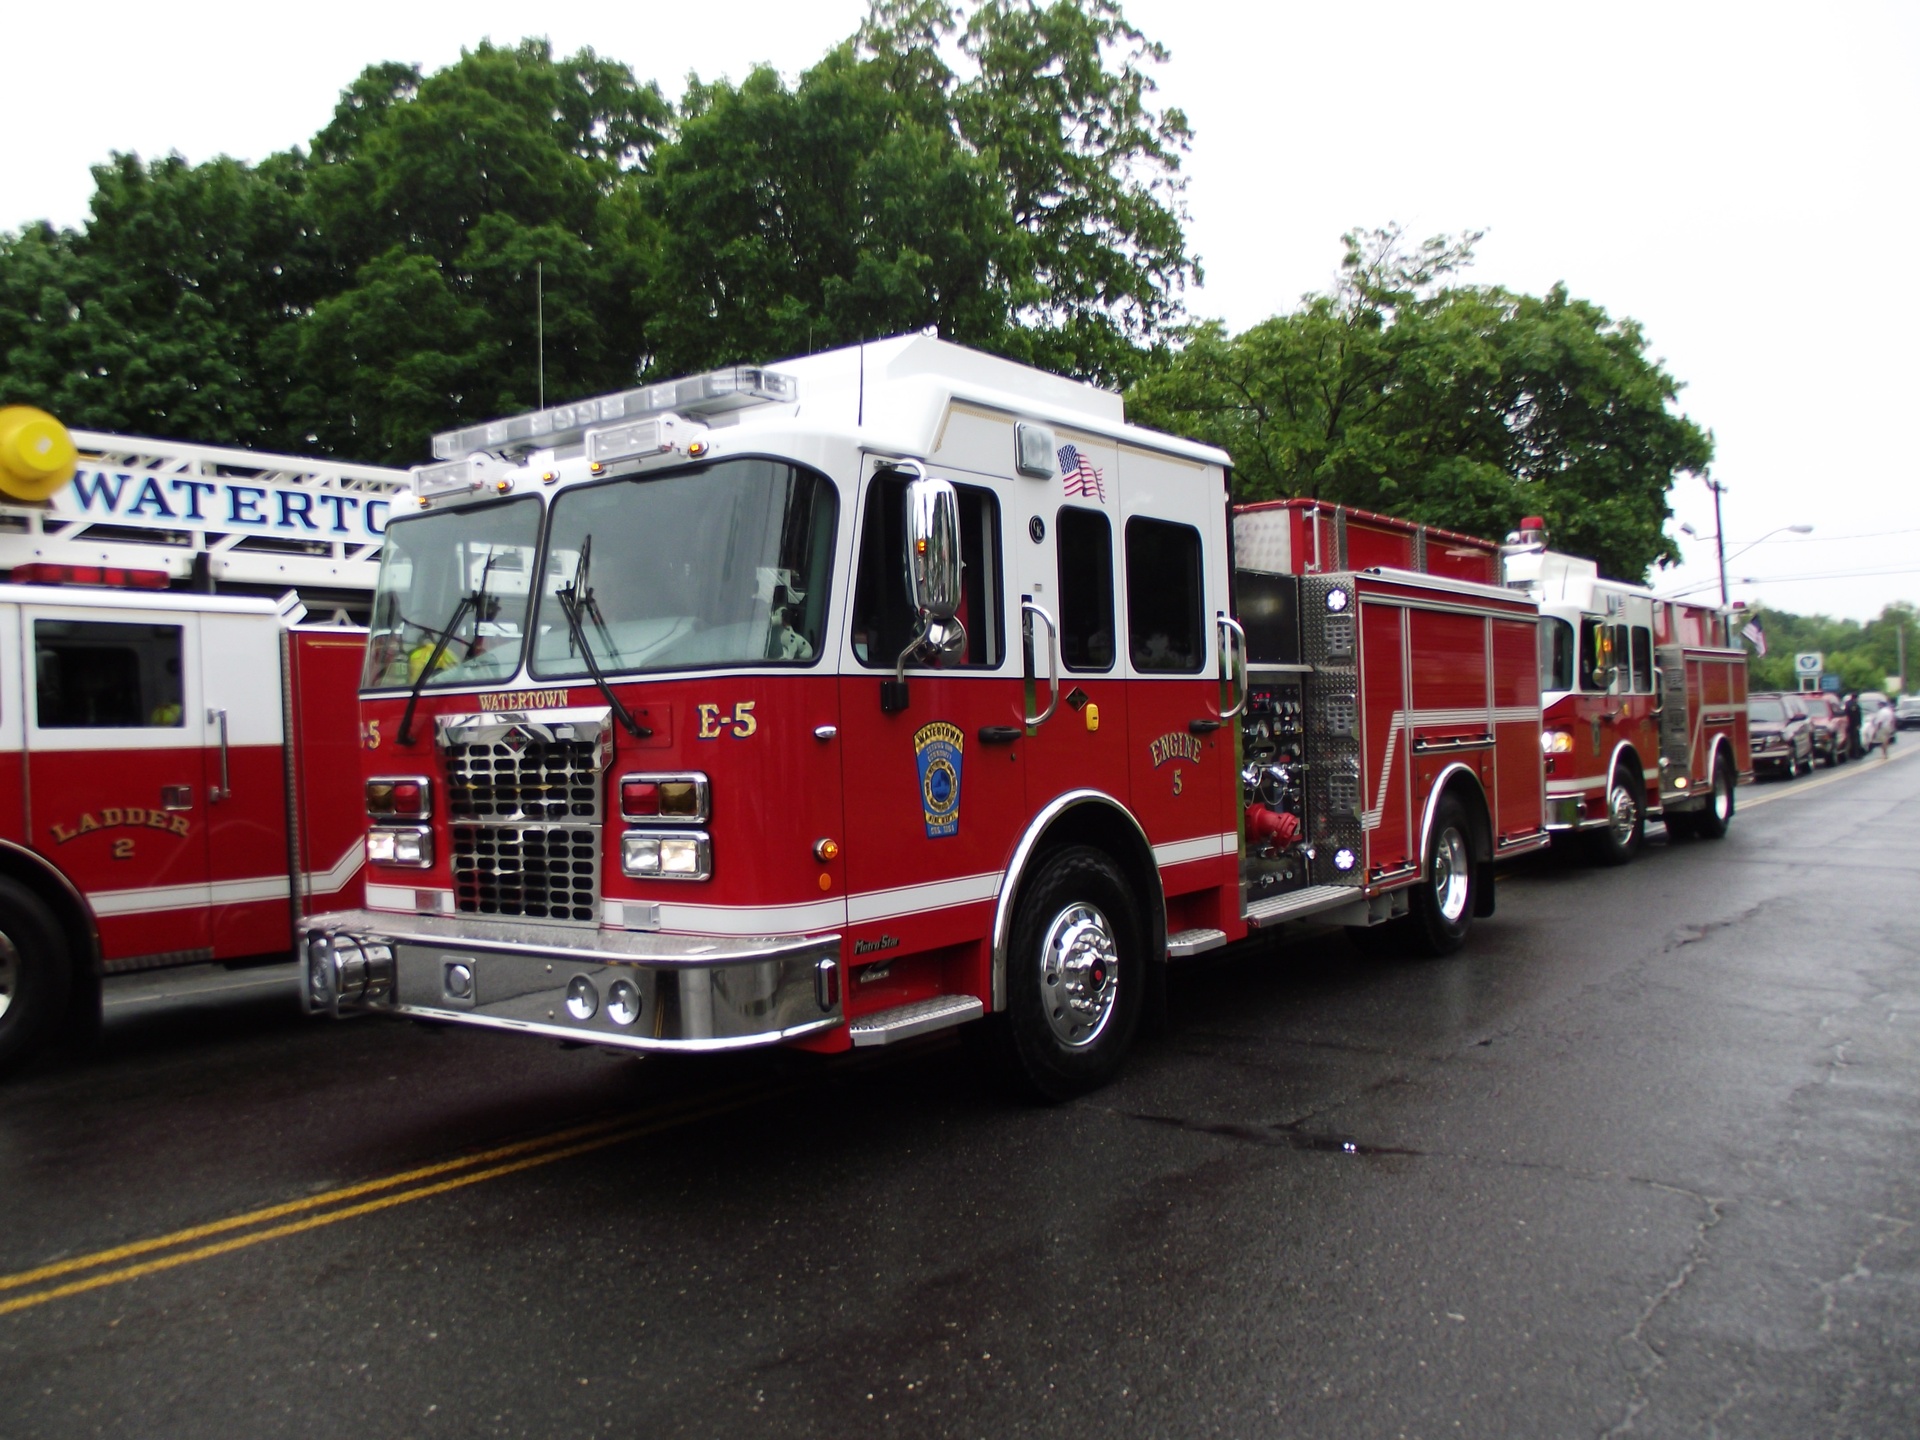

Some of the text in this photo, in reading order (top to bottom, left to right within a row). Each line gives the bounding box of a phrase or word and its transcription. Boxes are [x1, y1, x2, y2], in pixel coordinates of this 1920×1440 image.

[479, 690, 569, 712] WATERTOWN
[697, 700, 758, 739] E-5
[918, 726, 961, 744] WATERTOWN
[1149, 732, 1202, 768] ENGINE
[1173, 768, 1183, 796] 5
[51, 807, 191, 844] LADDER
[113, 837, 136, 858] 2
